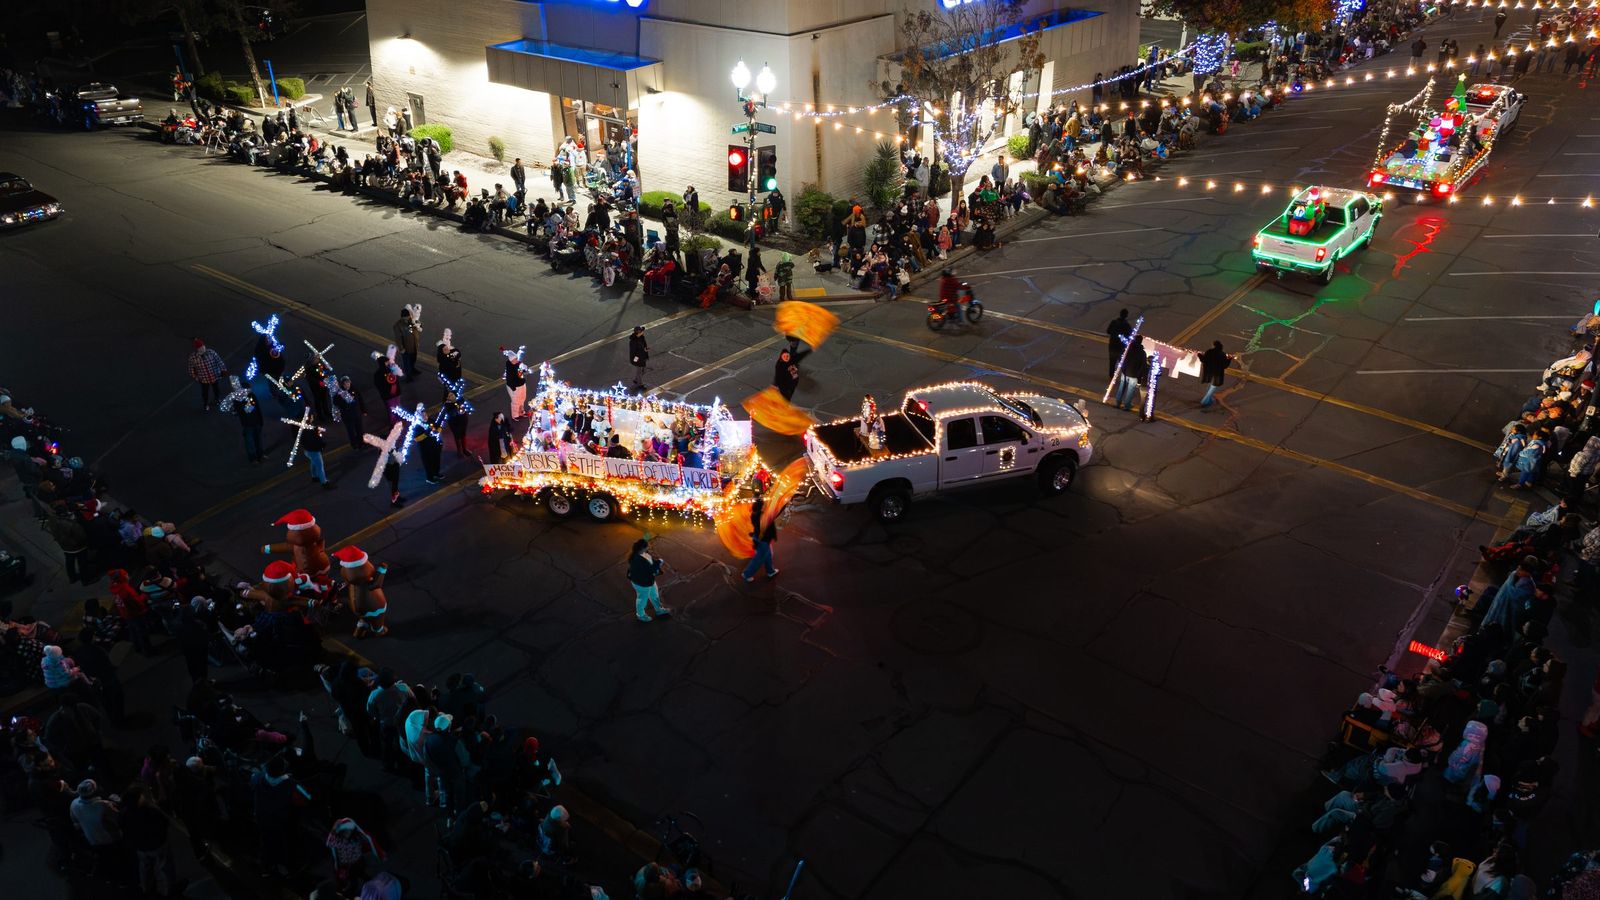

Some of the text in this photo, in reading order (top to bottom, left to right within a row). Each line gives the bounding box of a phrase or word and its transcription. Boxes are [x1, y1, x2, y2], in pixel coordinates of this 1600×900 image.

[1050, 438, 1060, 446] 28
[523, 453, 559, 470] JESUS
[577, 457, 601, 476] THE
[605, 460, 640, 478] LIGHT
[643, 464, 657, 478] OF
[657, 464, 677, 481] THE
[683, 469, 719, 489] WORLD
